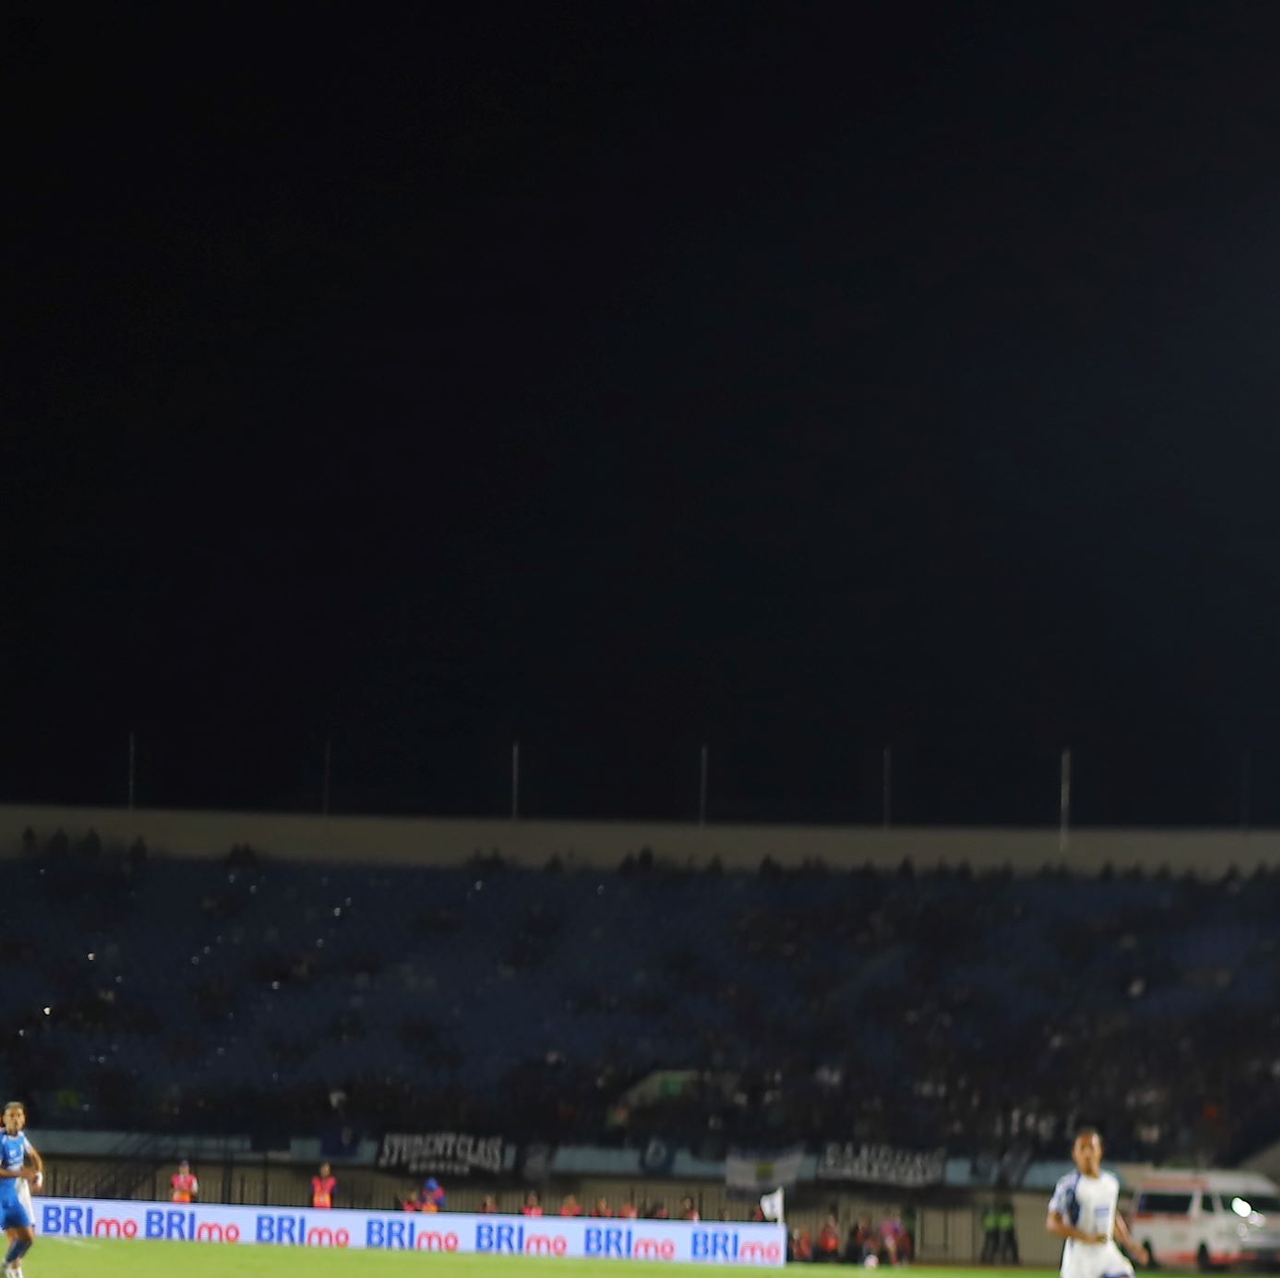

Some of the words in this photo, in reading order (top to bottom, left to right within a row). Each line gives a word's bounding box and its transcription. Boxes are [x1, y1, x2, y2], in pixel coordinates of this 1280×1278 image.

[42, 1205, 138, 1239] BRImo
[145, 1209, 240, 1243] BRImo
[256, 1214, 349, 1248] BRImo
[366, 1218, 459, 1252] BRImo
[475, 1223, 567, 1256] BRImo
[585, 1226, 675, 1260] BRImo
[691, 1229, 781, 1263] BRImo
